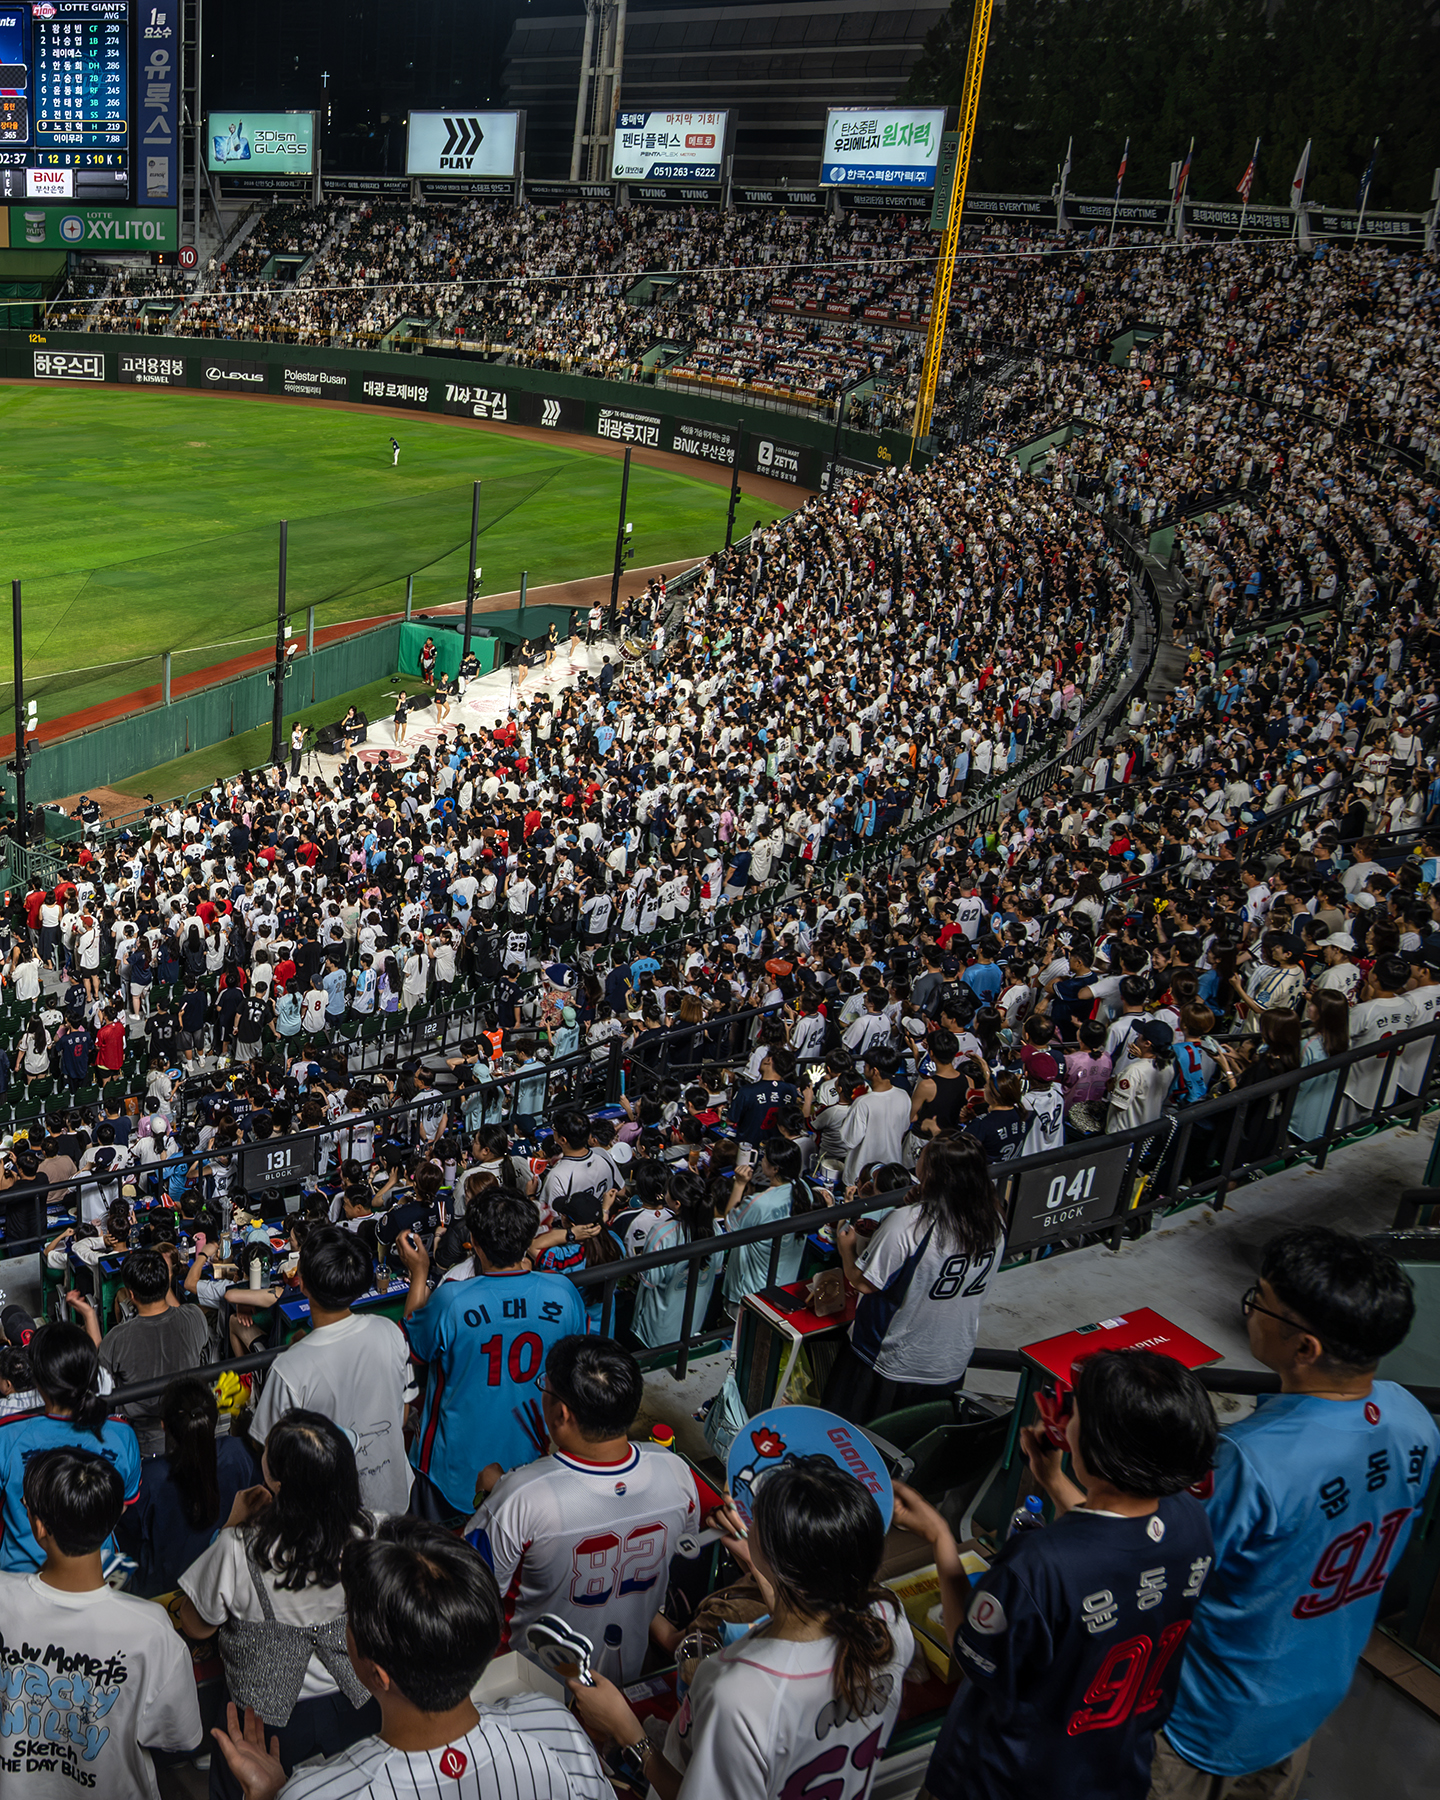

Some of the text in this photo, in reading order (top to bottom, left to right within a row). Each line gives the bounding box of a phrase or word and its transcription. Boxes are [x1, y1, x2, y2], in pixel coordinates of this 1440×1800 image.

[60, 3, 126, 11] LOTTE GIANTS
[150, 7, 166, 26] 1등
[40, 24, 46, 32] 1
[143, 26, 172, 39] 요소수
[40, 36, 46, 45] 2
[89, 37, 98, 45] 1B
[40, 49, 46, 57] 3
[40, 61, 46, 70] 4
[88, 62, 100, 70] DH
[41, 74, 46, 82] 5
[90, 74, 98, 82] 2B
[41, 86, 47, 94] 6
[143, 49, 172, 144] 유록스
[41, 98, 47, 106] 7
[6, 113, 12, 121] 5
[41, 110, 47, 118] 8
[666, 113, 720, 126] 마지막 기회!
[41, 122, 47, 130] 9
[91, 123, 98, 131] H
[841, 119, 878, 137] 탄소중립
[91, 135, 98, 143] P
[621, 132, 713, 149] 펜타플렉스 메트로
[834, 122, 932, 153] 우리에너지 원자력
[254, 143, 308, 154] GLASS
[38, 154, 122, 164] T 12 B 2 S 10 K 1
[440, 157, 474, 169] PLAY
[5, 169, 11, 177] H
[33, 172, 64, 182] BNK
[654, 166, 672, 177] 051)
[673, 167, 688, 177] 263
[695, 168, 716, 178] 6222
[847, 169, 927, 182] 한국수력원자력(주)
[5, 179, 11, 187] E
[35, 185, 64, 194] 부산은행
[580, 187, 611, 197] TVING
[639, 188, 667, 198] TVING
[680, 190, 709, 199] TVING
[745, 191, 773, 202] TVING
[787, 192, 817, 203] TVING
[935, 163, 951, 221] GLASS
[1192, 208, 1239, 224] 롯데자이언츠
[87, 220, 165, 240] XYLITOL
[181, 251, 194, 264] 10
[28, 334, 47, 343] 121m
[121, 357, 184, 376] 고려용접봉
[143, 374, 170, 384] KISWEL
[222, 370, 264, 382] LEXUS
[284, 369, 347, 385] Polestar Busan
[541, 418, 558, 427] PLAY
[597, 418, 660, 447] 태광후지킨
[673, 436, 735, 464] BNK 부산은행
[762, 446, 770, 460] Z
[877, 445, 892, 462] 96m
[773, 454, 798, 472] ZETTA
[596, 903, 609, 916] 82
[960, 908, 979, 922] 82
[510, 942, 526, 952] 29
[314, 1000, 321, 1012] 8
[157, 1026, 173, 1040] 13
[424, 1022, 438, 1034] 122
[807, 1029, 824, 1049] 82
[869, 1031, 890, 1048] 82
[756, 1091, 792, 1105] 전준우
[233, 1105, 244, 1114] PARK
[427, 1101, 444, 1121] 82
[267, 1148, 291, 1171] 131
[265, 1169, 292, 1181] BLOCK
[1046, 1166, 1096, 1209] 041
[1043, 1206, 1084, 1228] BLOCK
[928, 1247, 996, 1301] 82
[464, 1298, 563, 1329] 이대호
[480, 1331, 543, 1387] 10
[826, 1426, 885, 1496] Giants
[569, 1520, 668, 1608] 82
[1291, 1507, 1415, 1620] 91
[1081, 1555, 1212, 1634] 윤동희
[0, 1631, 42, 1666] raw
[1067, 1619, 1192, 1736] 91
[26, 1758, 59, 1773] DAY
